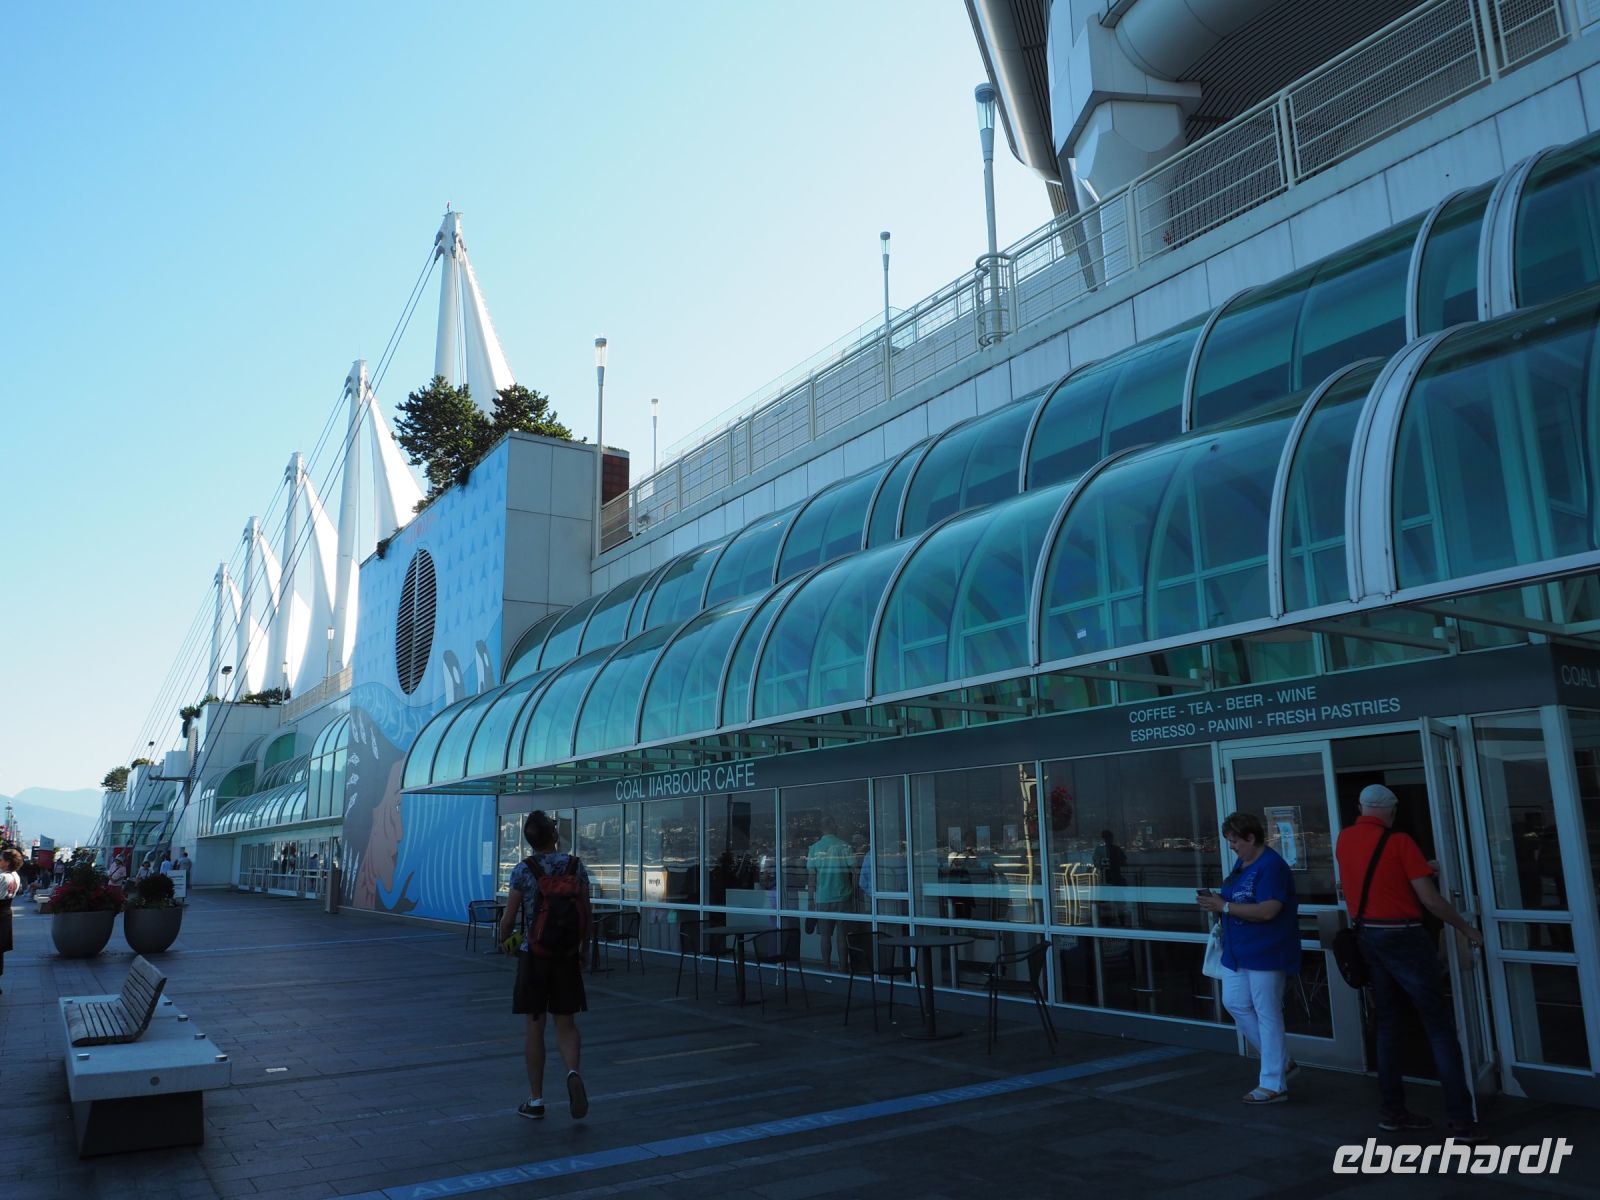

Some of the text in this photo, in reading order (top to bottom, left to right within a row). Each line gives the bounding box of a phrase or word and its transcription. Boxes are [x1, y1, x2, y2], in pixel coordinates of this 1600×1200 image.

[1560, 664, 1597, 688] COAL
[1129, 704, 1176, 724] COFFEE
[1187, 701, 1214, 717] TEA
[1225, 693, 1264, 712] BEER
[1276, 686, 1317, 705] WINE
[1130, 723, 1196, 743] ESPRESSO
[1208, 716, 1253, 733] PANINI
[1267, 708, 1317, 728] FRESH
[1321, 697, 1401, 721] PASTRIES
[615, 778, 645, 801] COAL
[715, 763, 756, 790] CAFE
[411, 1159, 595, 1198] ALBERTA
